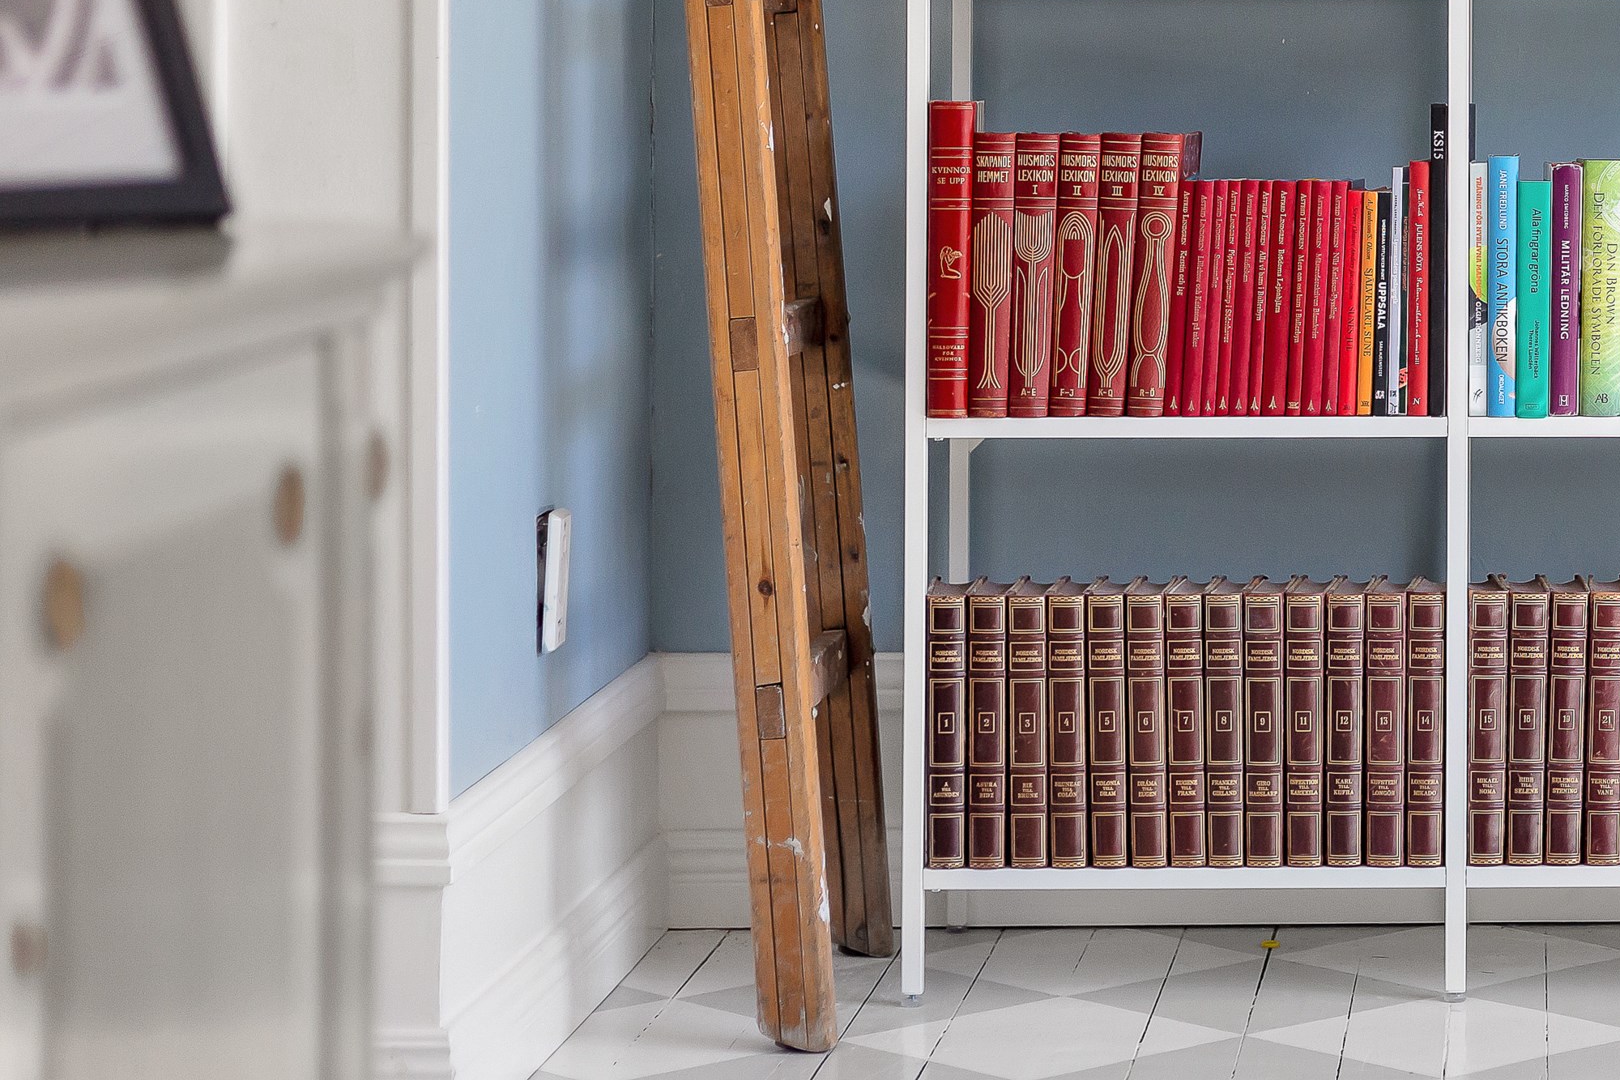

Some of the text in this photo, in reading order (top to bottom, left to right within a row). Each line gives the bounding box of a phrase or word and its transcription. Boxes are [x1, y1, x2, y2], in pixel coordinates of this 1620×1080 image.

[1433, 130, 1444, 160] KS15
[976, 156, 1011, 168] SKAPANDE
[1017, 154, 1055, 168] HUSMORS
[1060, 154, 1098, 168] HUSMORS
[1101, 154, 1138, 168] HUSMORS
[1142, 154, 1179, 168] HUSMORS
[949, 177, 965, 185] UPP
[977, 171, 1009, 183] HEMMET
[1018, 170, 1054, 183] LEXIKON
[1061, 170, 1095, 183] LEXIKON
[1101, 170, 1136, 183] LEXIKON
[1142, 170, 1177, 183] LEXIKON
[1176, 191, 1190, 296] ASTRID LINDGREN Kerstin och jag
[1415, 223, 1424, 272] JULENS SÖTA
[1529, 208, 1542, 293] Alla fingrar gröna
[1495, 169, 1509, 362] JANE FREDLUND STORA ANTIKBOKEN
[1560, 240, 1571, 285] MILITÄR
[1590, 192, 1605, 375] DEN FÖRLORADE SYMBOLEN
[1606, 243, 1618, 325] DAN BROWN
[1377, 281, 1387, 330] UPPSALA
[1560, 288, 1570, 340] LEDNING
[983, 719, 990, 727] 2
[1024, 719, 1031, 728] 3
[1063, 718, 1069, 727] 4
[1104, 717, 1110, 725] 5
[1339, 716, 1349, 724] 12
